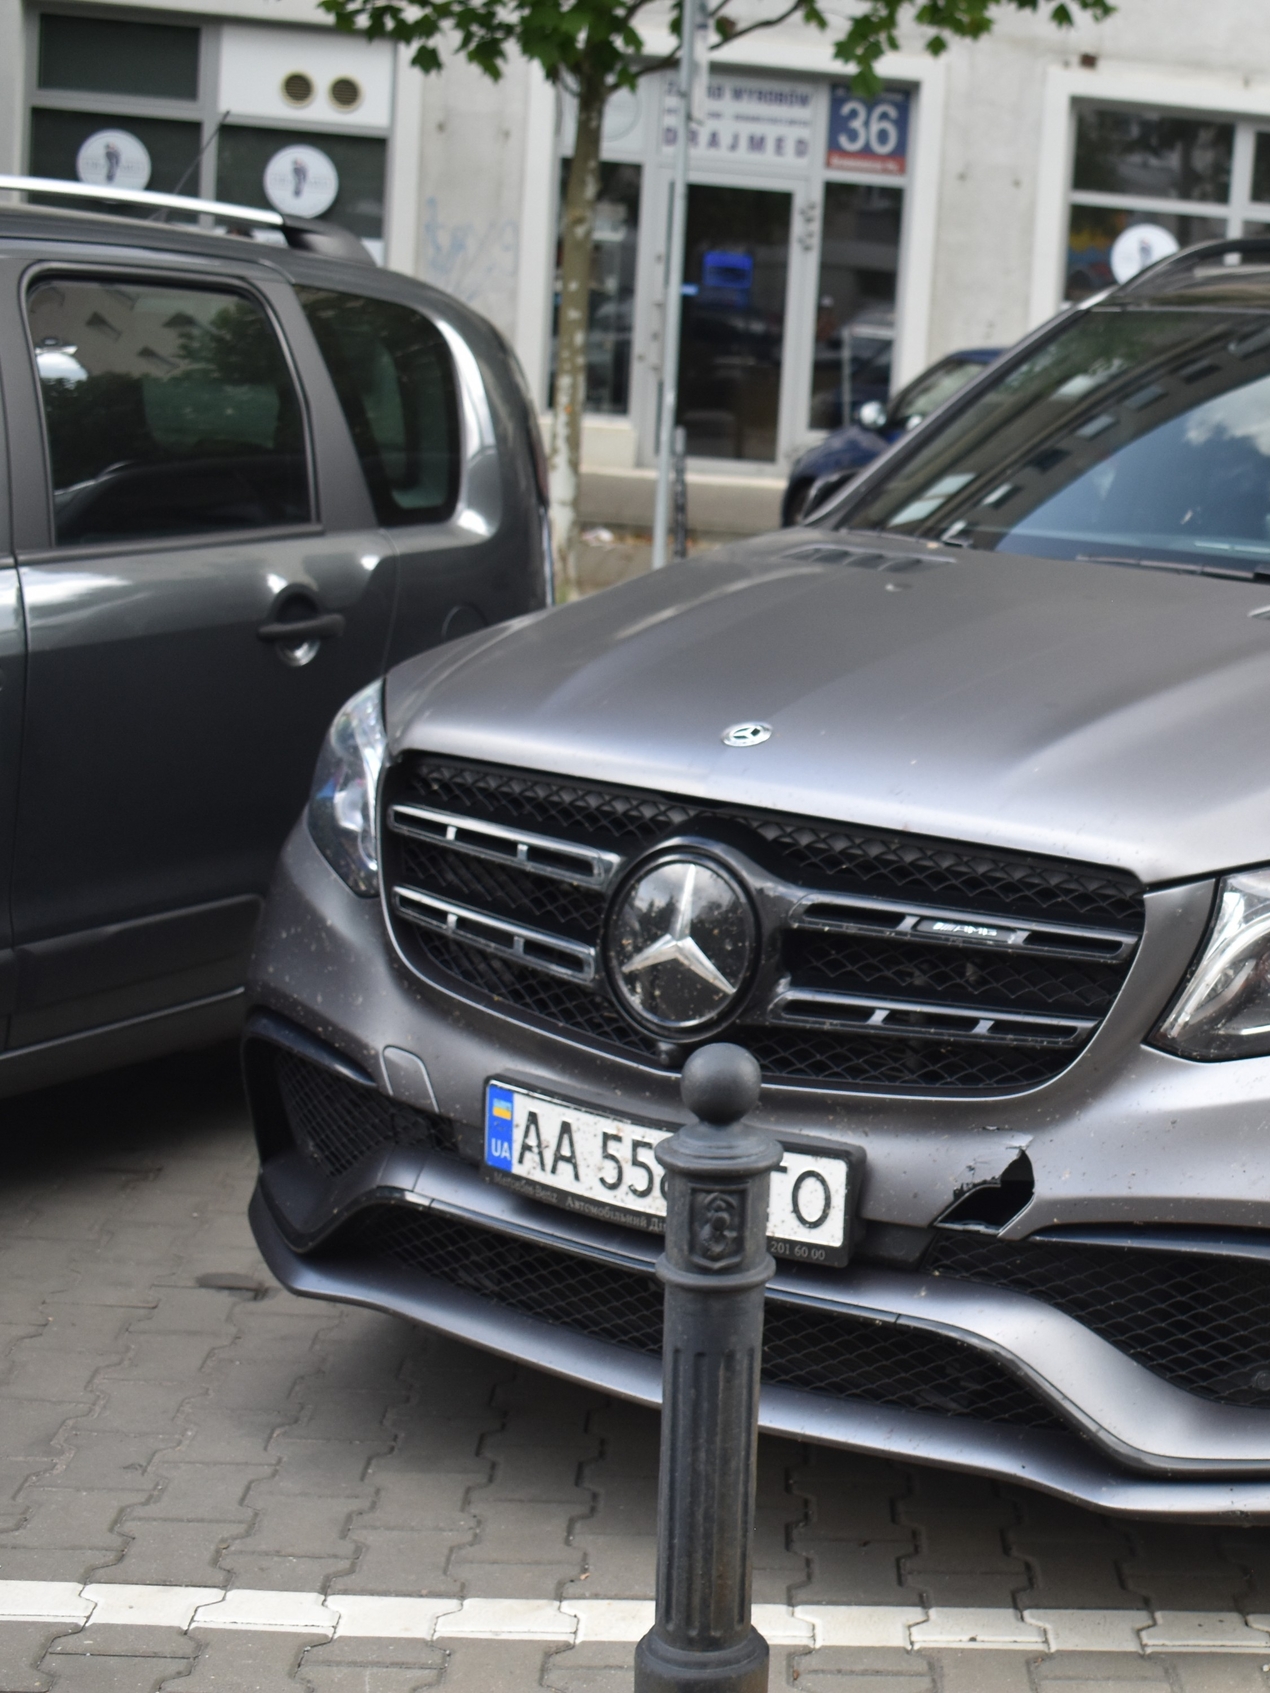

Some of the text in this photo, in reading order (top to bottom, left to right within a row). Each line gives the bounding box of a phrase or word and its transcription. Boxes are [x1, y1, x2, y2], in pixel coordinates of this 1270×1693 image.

[838, 100, 899, 156] 36
[491, 1137, 511, 1162] UA
[517, 1110, 581, 1183] AA
[770, 1240, 827, 1261] 201 60 00
